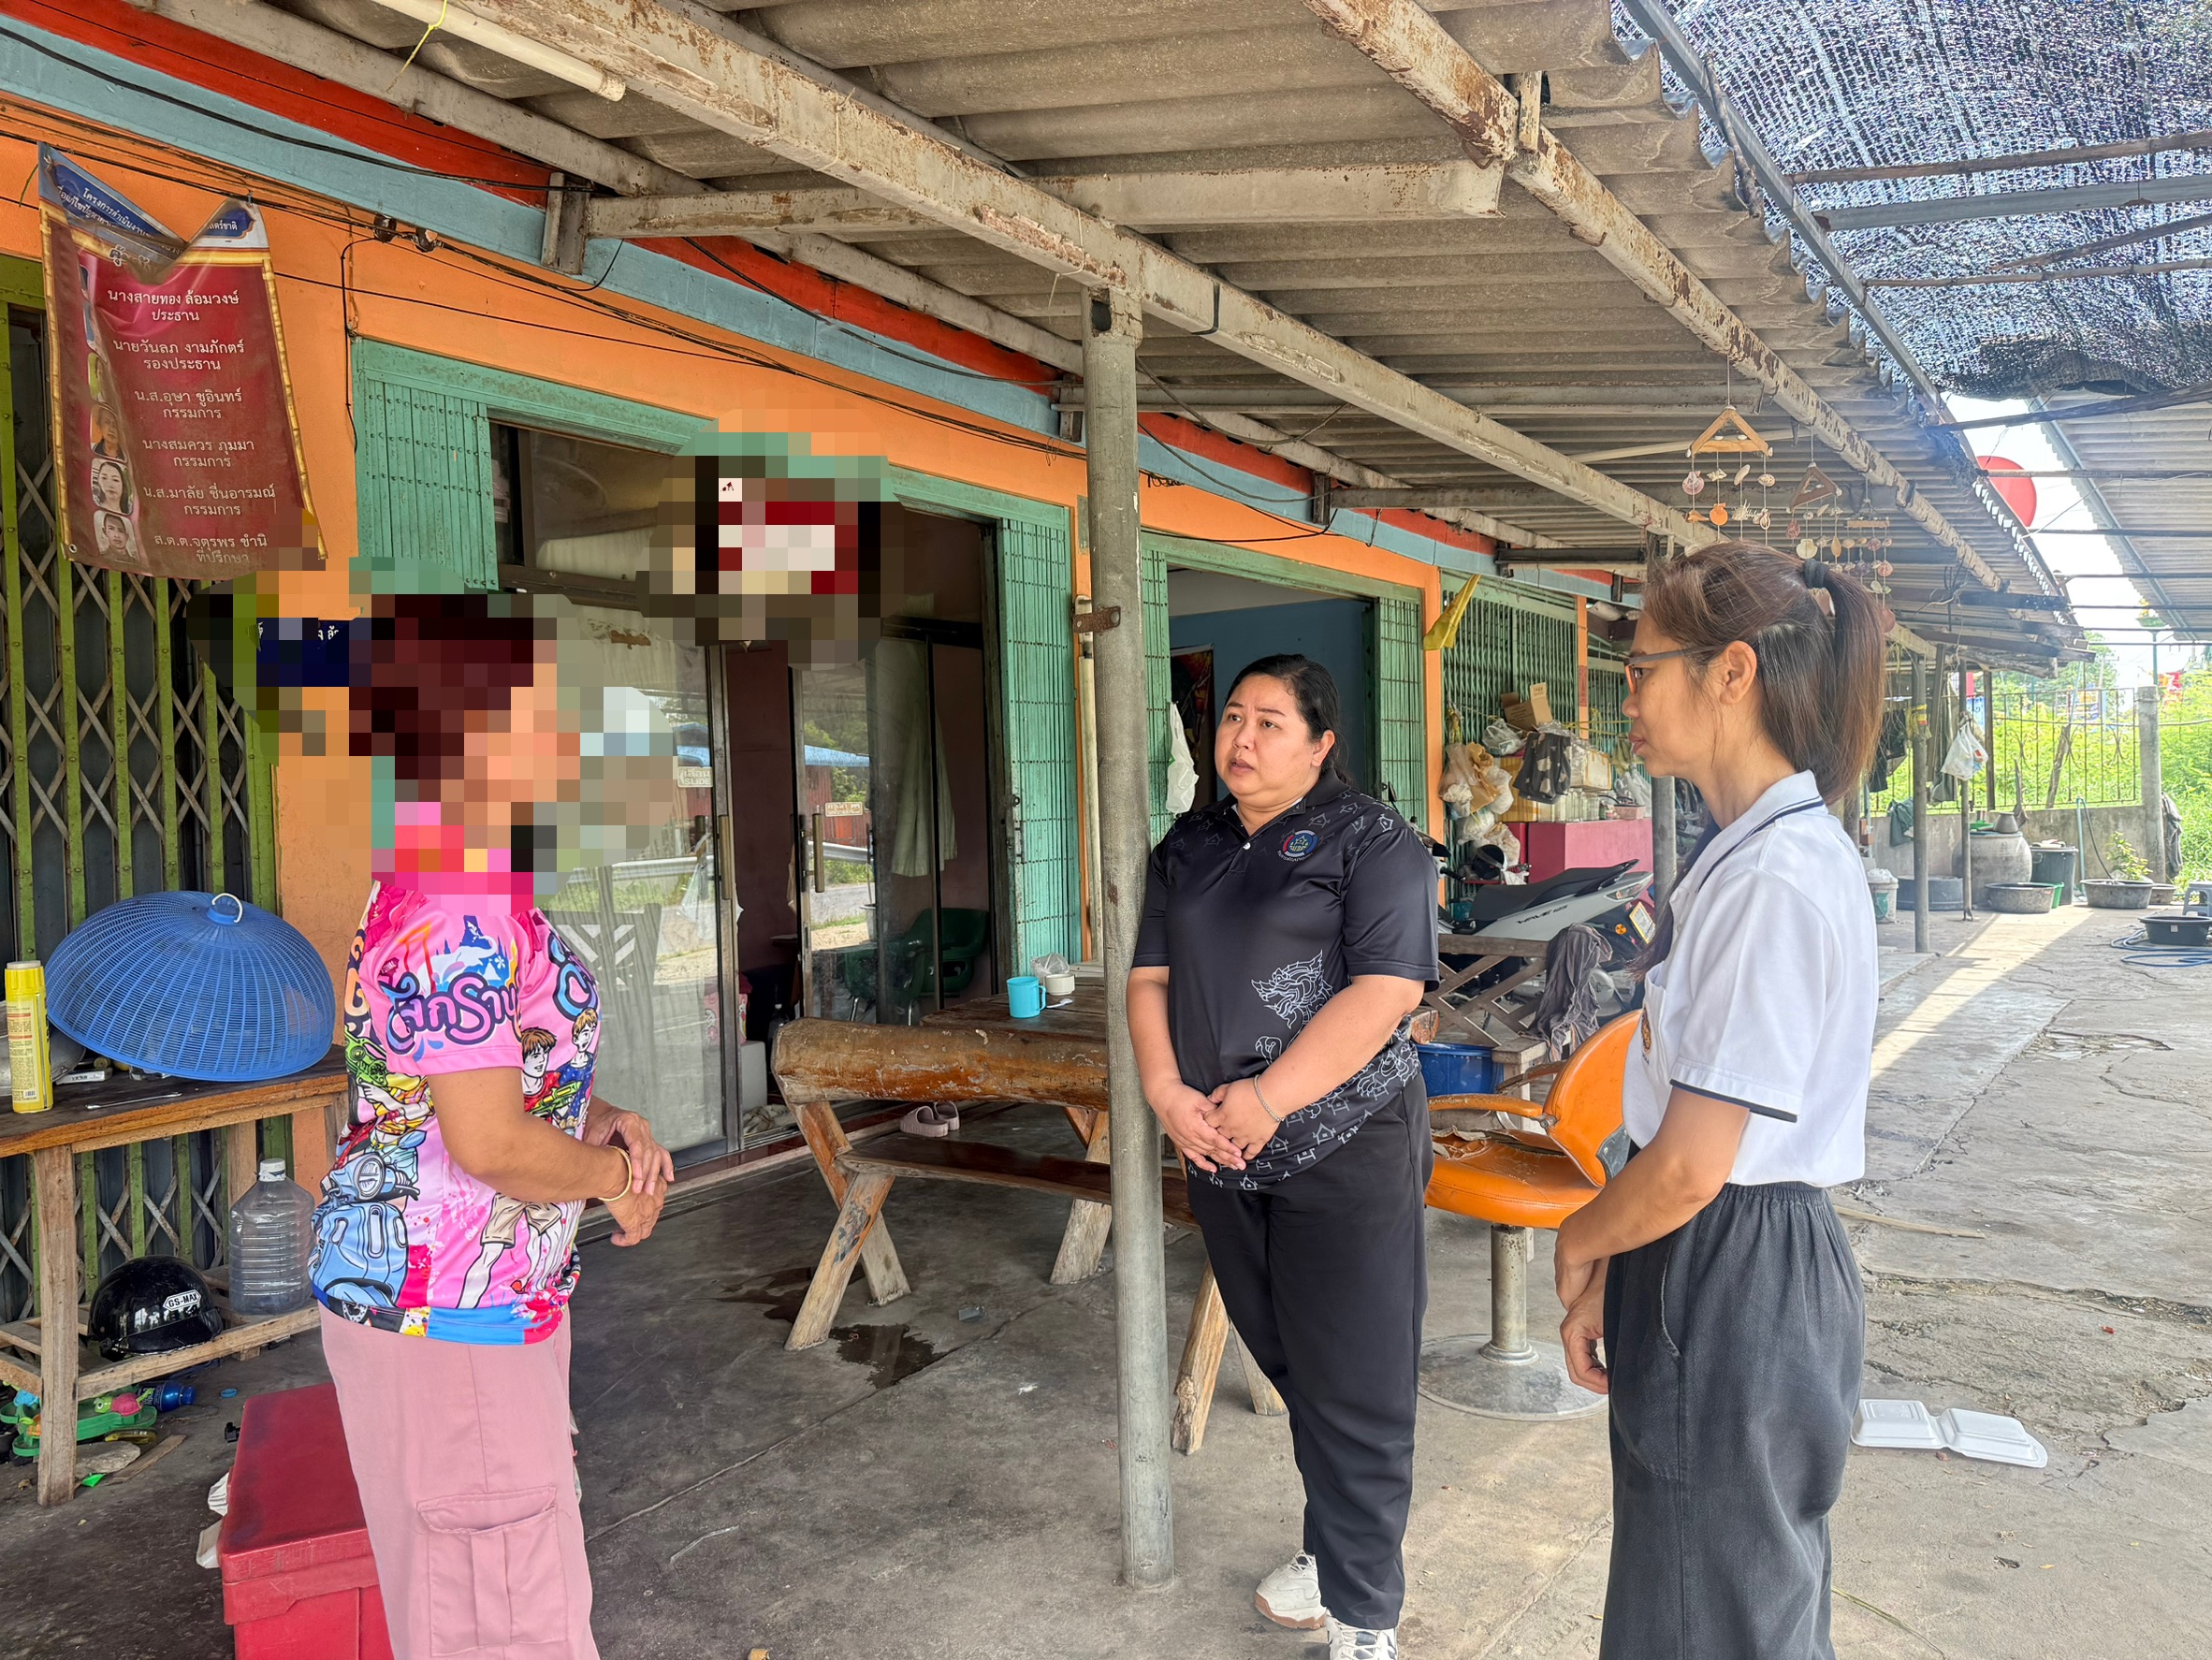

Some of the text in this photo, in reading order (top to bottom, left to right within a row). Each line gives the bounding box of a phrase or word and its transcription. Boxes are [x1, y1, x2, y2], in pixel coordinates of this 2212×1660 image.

[152, 309, 200, 322] ประธาน
[143, 357, 221, 371] รองประธาน
[163, 408, 222, 419] กรรมการ
[142, 439, 212, 451] นางสมควร
[173, 457, 231, 468] กรรมการ
[183, 504, 241, 516] กรรมการ
[167, 1292, 198, 1308] GS-MAX
